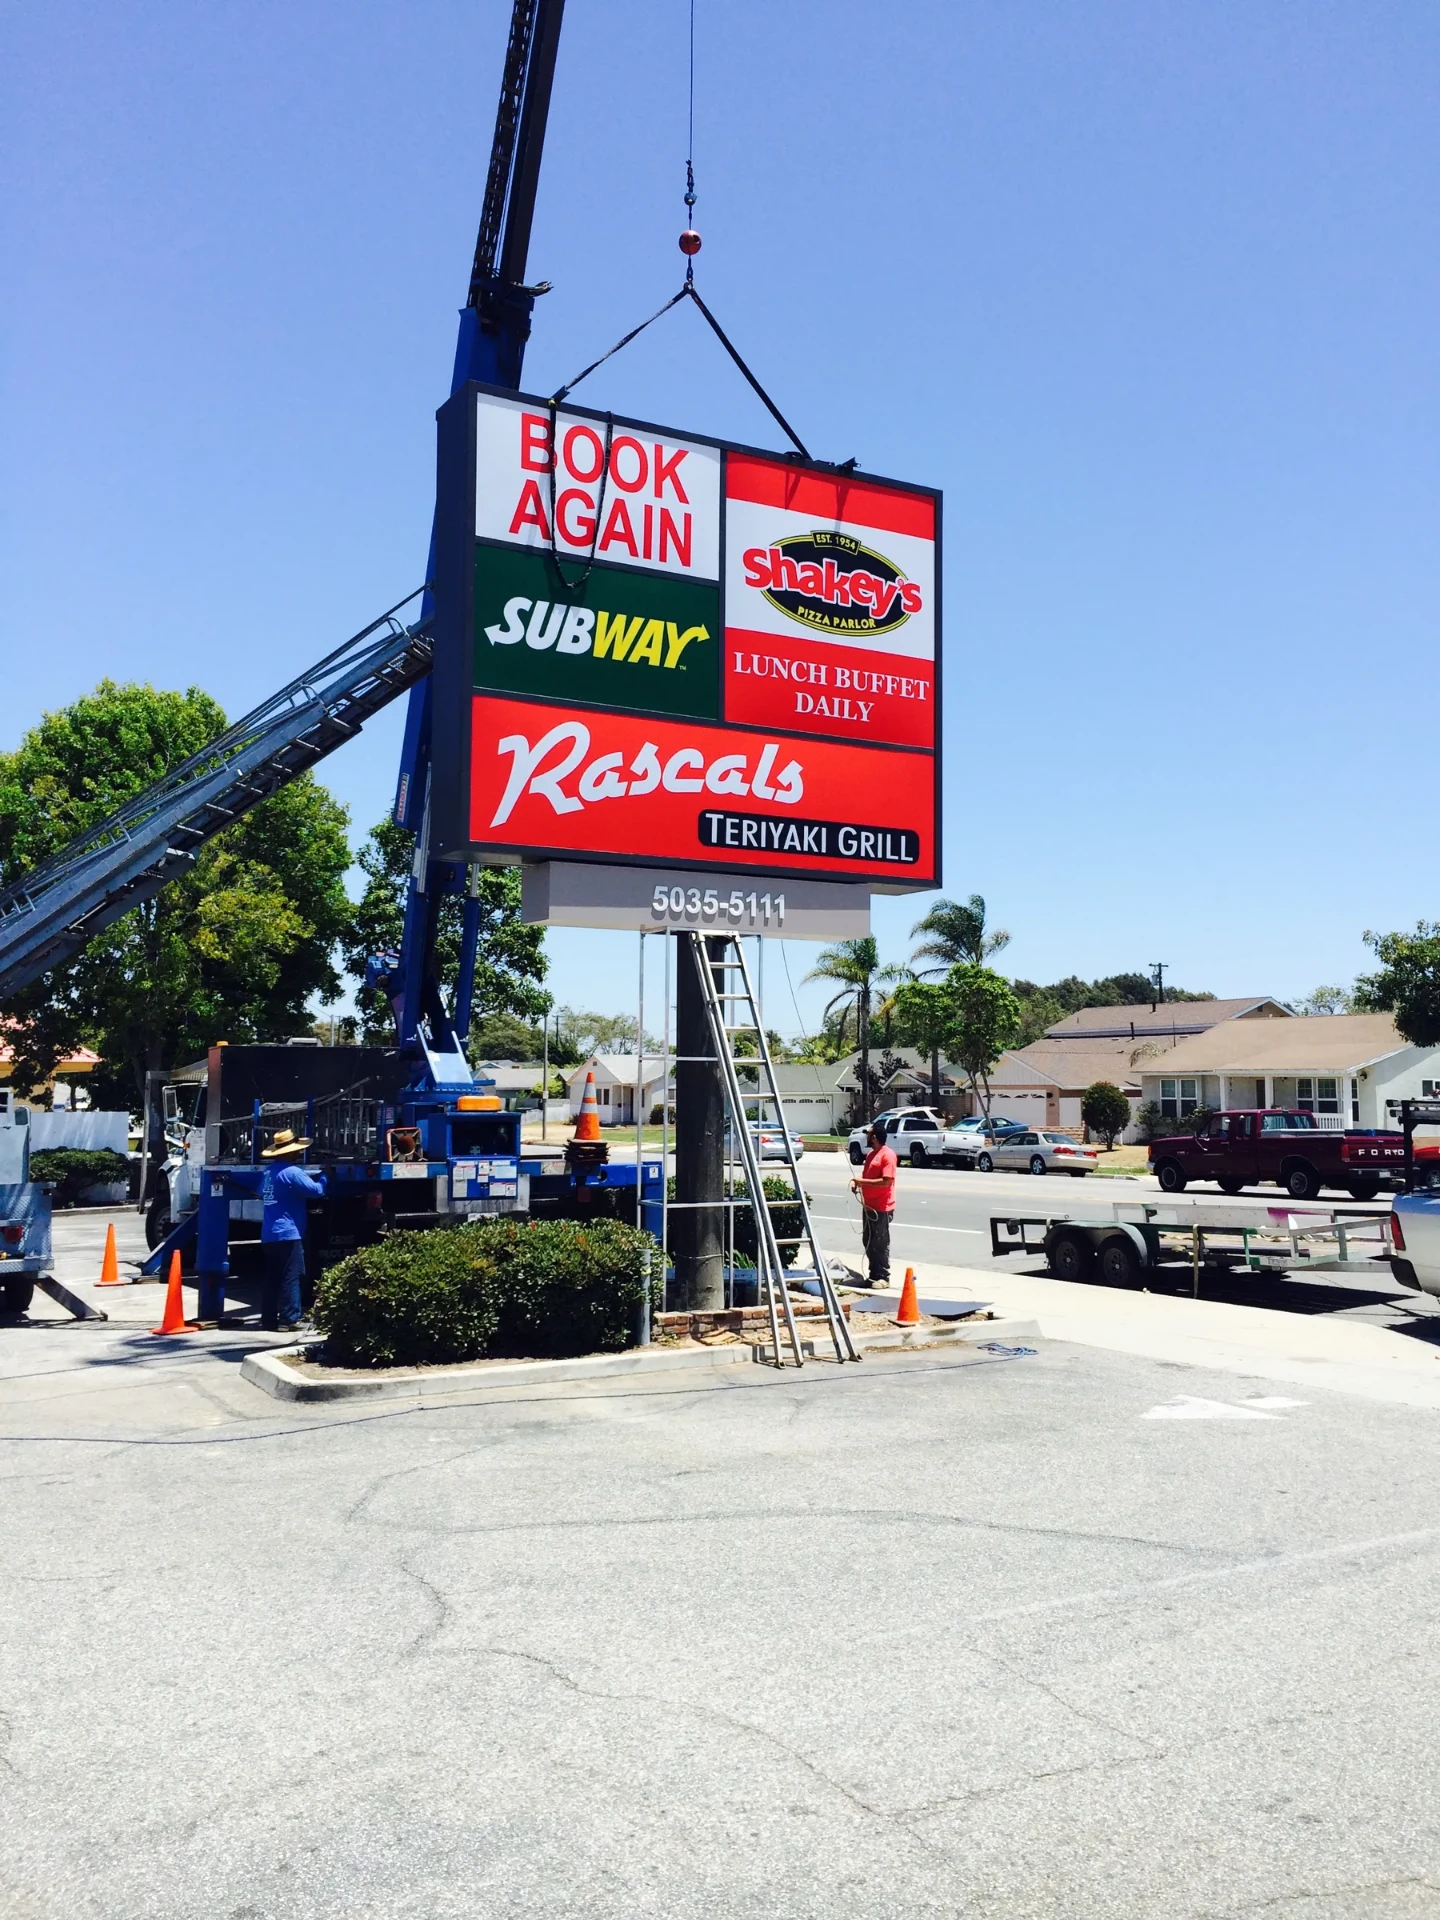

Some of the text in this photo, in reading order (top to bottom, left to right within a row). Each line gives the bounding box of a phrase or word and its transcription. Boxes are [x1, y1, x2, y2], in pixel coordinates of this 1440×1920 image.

[521, 412, 689, 505] BOOK
[509, 479, 692, 567] AGAIN
[816, 534, 856, 550] EST. 1954
[742, 548, 923, 618] Shakey's
[484, 596, 711, 669] SUBWAY
[798, 606, 876, 629] PIZZA PARLOR
[733, 652, 929, 700] LUNCH BUFFET
[795, 692, 874, 722] DAILY
[489, 721, 804, 828] Rascals
[705, 813, 914, 862] TERIYAKI GRILL
[652, 885, 785, 919] 5035-5111
